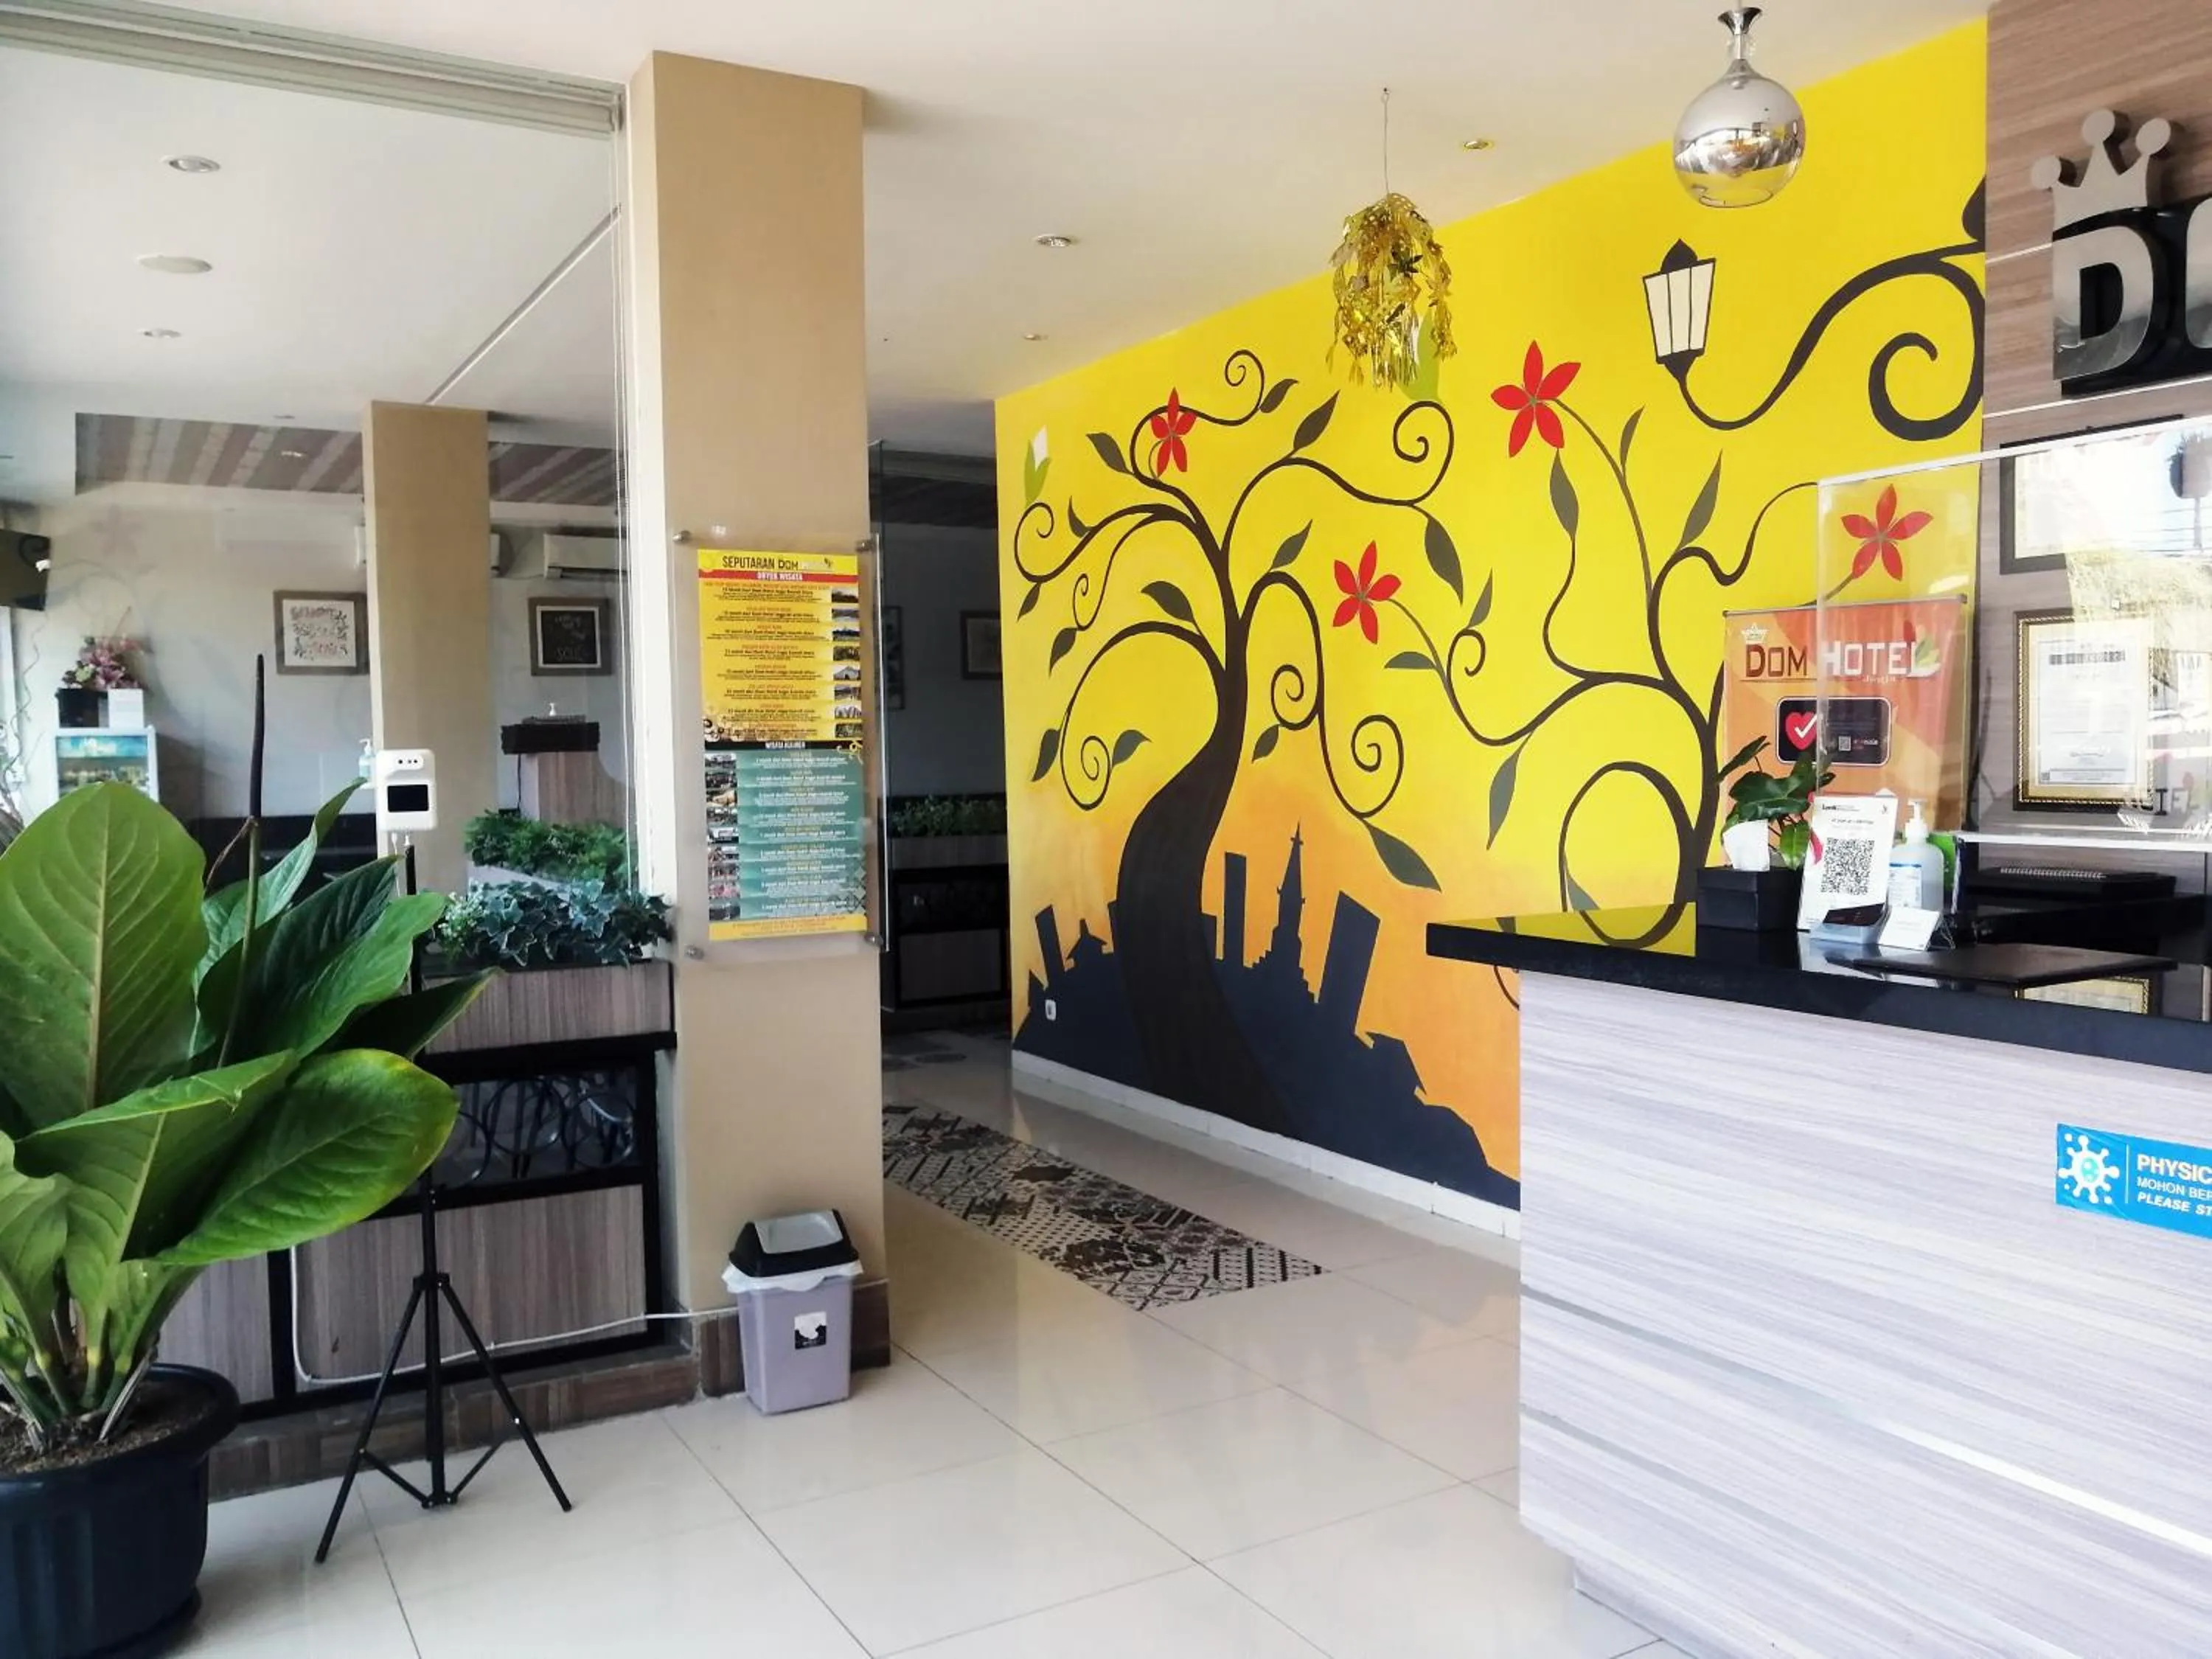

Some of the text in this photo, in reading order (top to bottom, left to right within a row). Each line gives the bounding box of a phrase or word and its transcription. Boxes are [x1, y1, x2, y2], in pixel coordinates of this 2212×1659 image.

[2053, 196, 2212, 380] D
[722, 555, 775, 568] SEPUTARAN
[1745, 640, 1941, 678] DOM HOTEL
[2137, 1153, 2212, 1185] PHYSIC
[2137, 1176, 2185, 1196] MOHON
[2137, 1192, 2191, 1212] PLEASE
